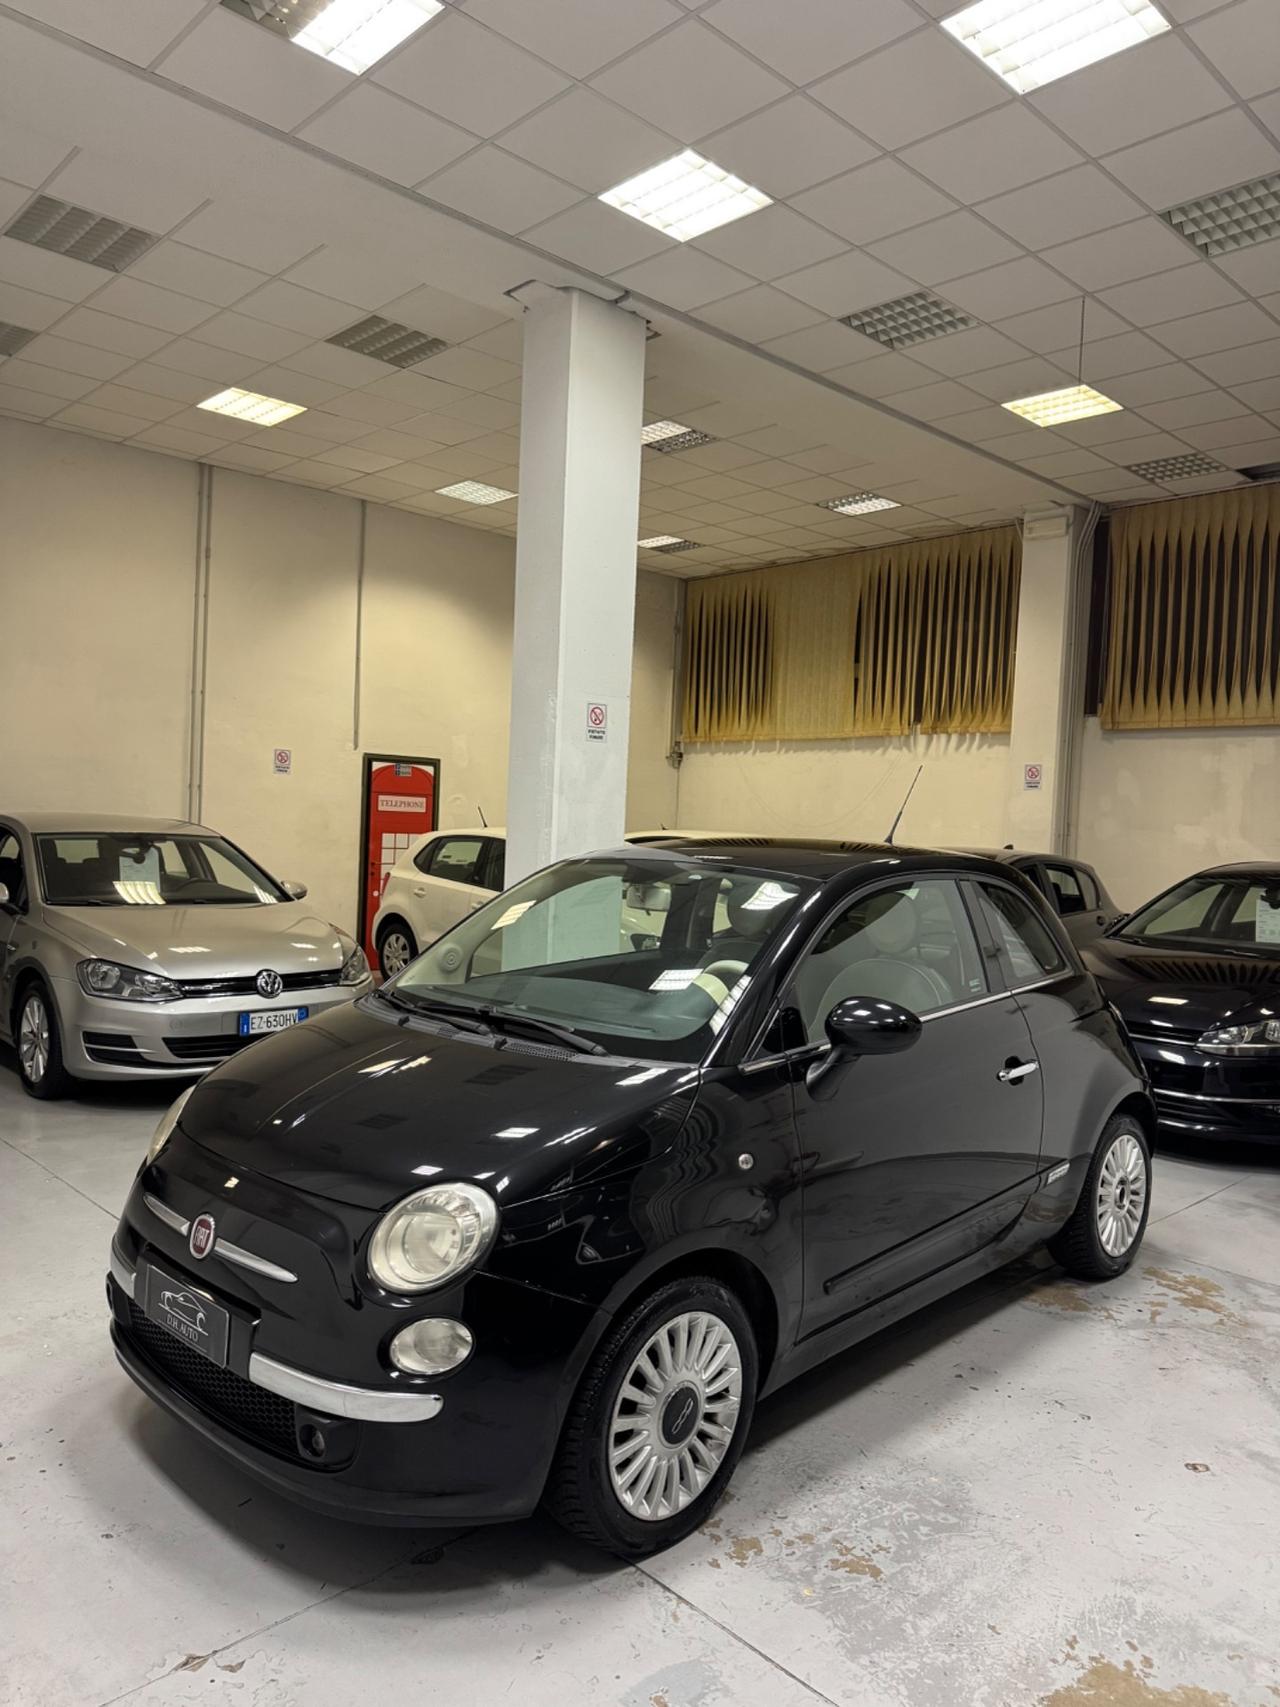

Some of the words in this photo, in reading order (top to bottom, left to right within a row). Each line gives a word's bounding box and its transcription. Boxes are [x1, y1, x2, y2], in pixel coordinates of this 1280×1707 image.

[380, 799, 425, 809] TELEPHONE
[192, 1225, 210, 1249] FIAT
[179, 1323, 199, 1342] AUTO
